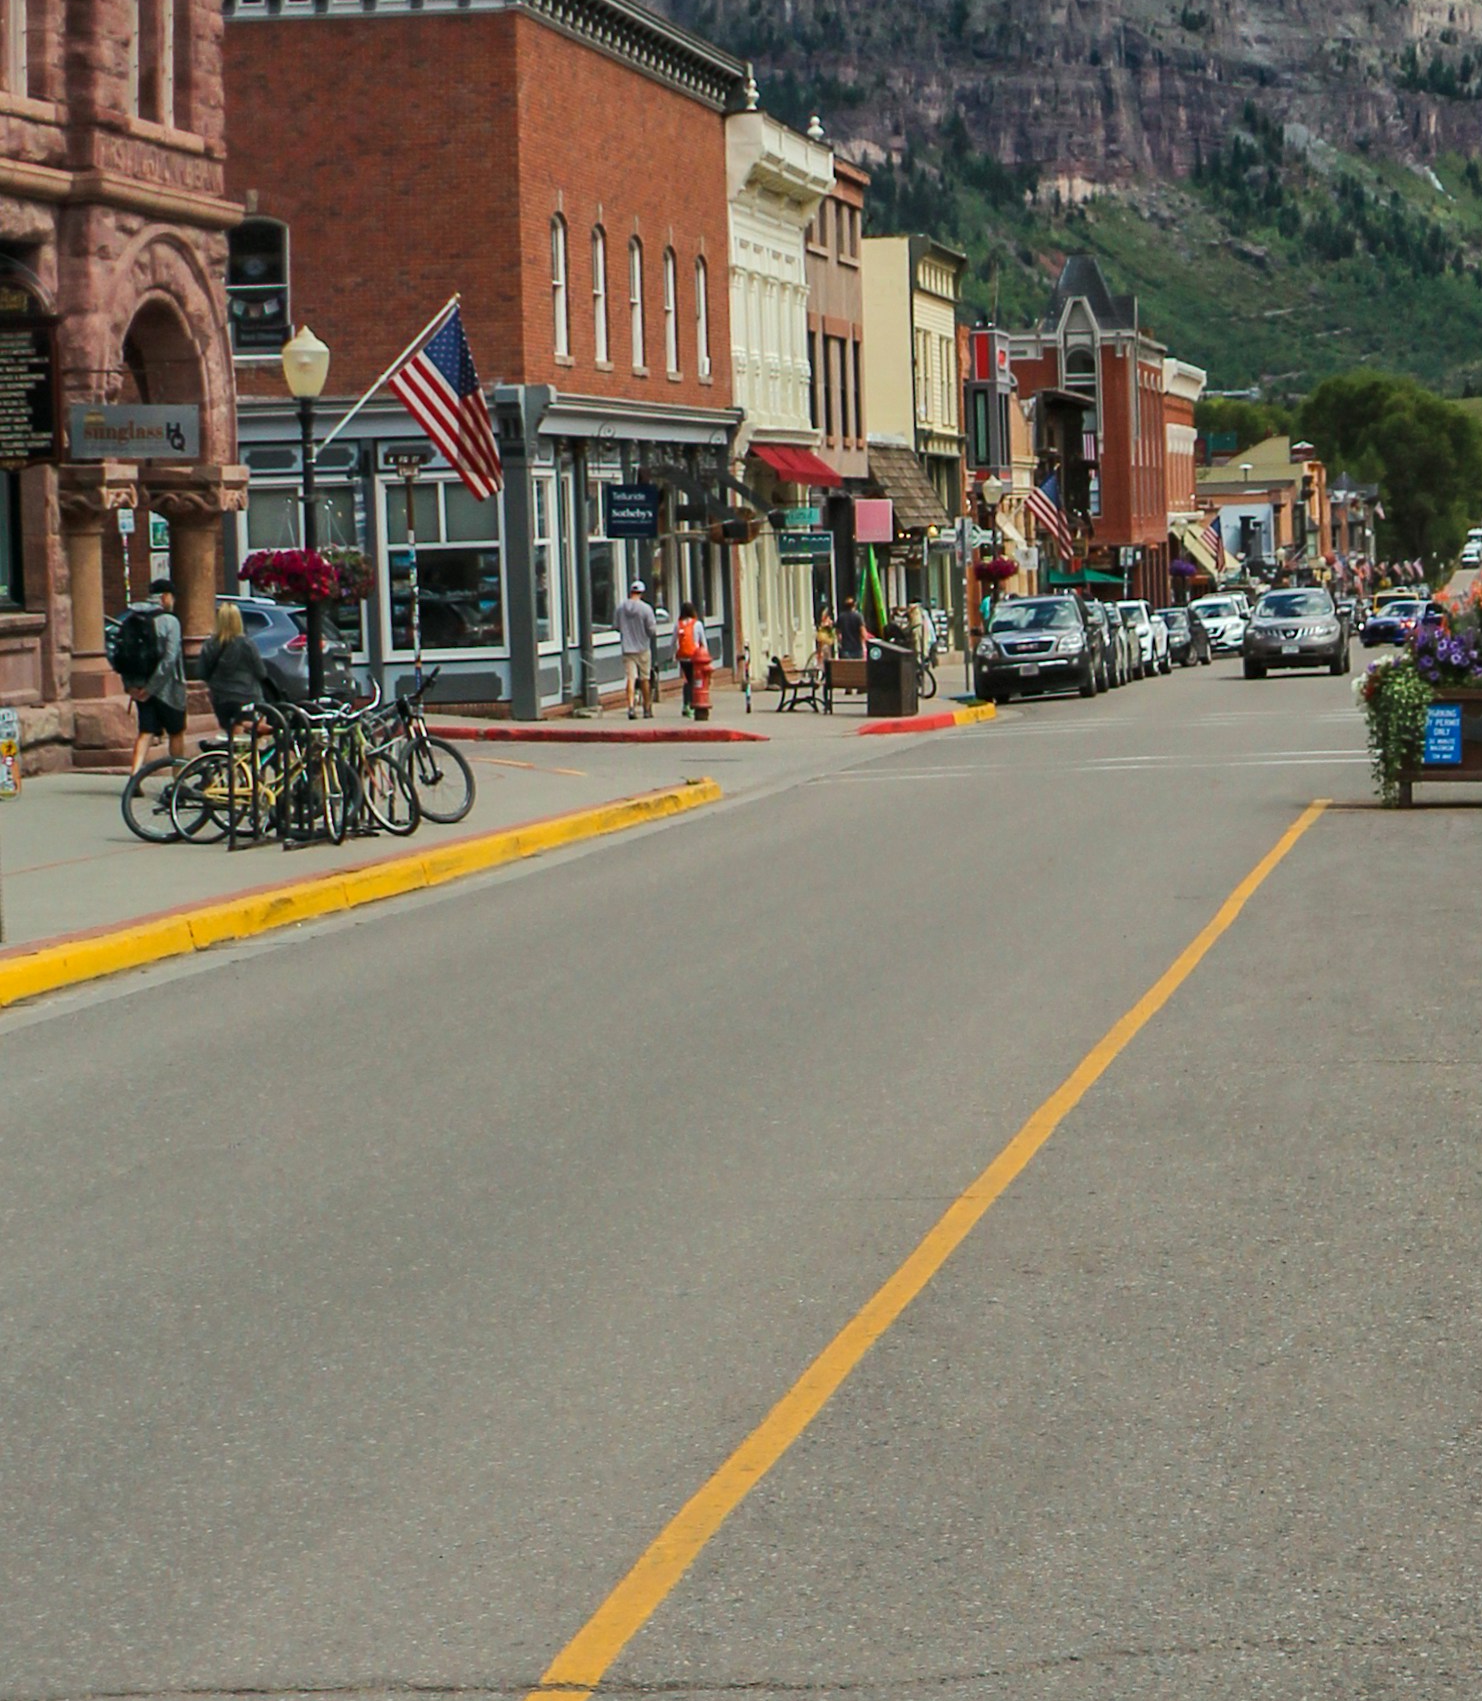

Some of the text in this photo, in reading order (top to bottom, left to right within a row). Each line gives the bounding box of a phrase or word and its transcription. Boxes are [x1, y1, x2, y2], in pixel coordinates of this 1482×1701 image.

[84, 420, 186, 452] sunglass HQ
[612, 508, 653, 520] Sotheby's
[1434, 718, 1460, 727] PERMIT
[1433, 727, 1451, 737] ONLY
